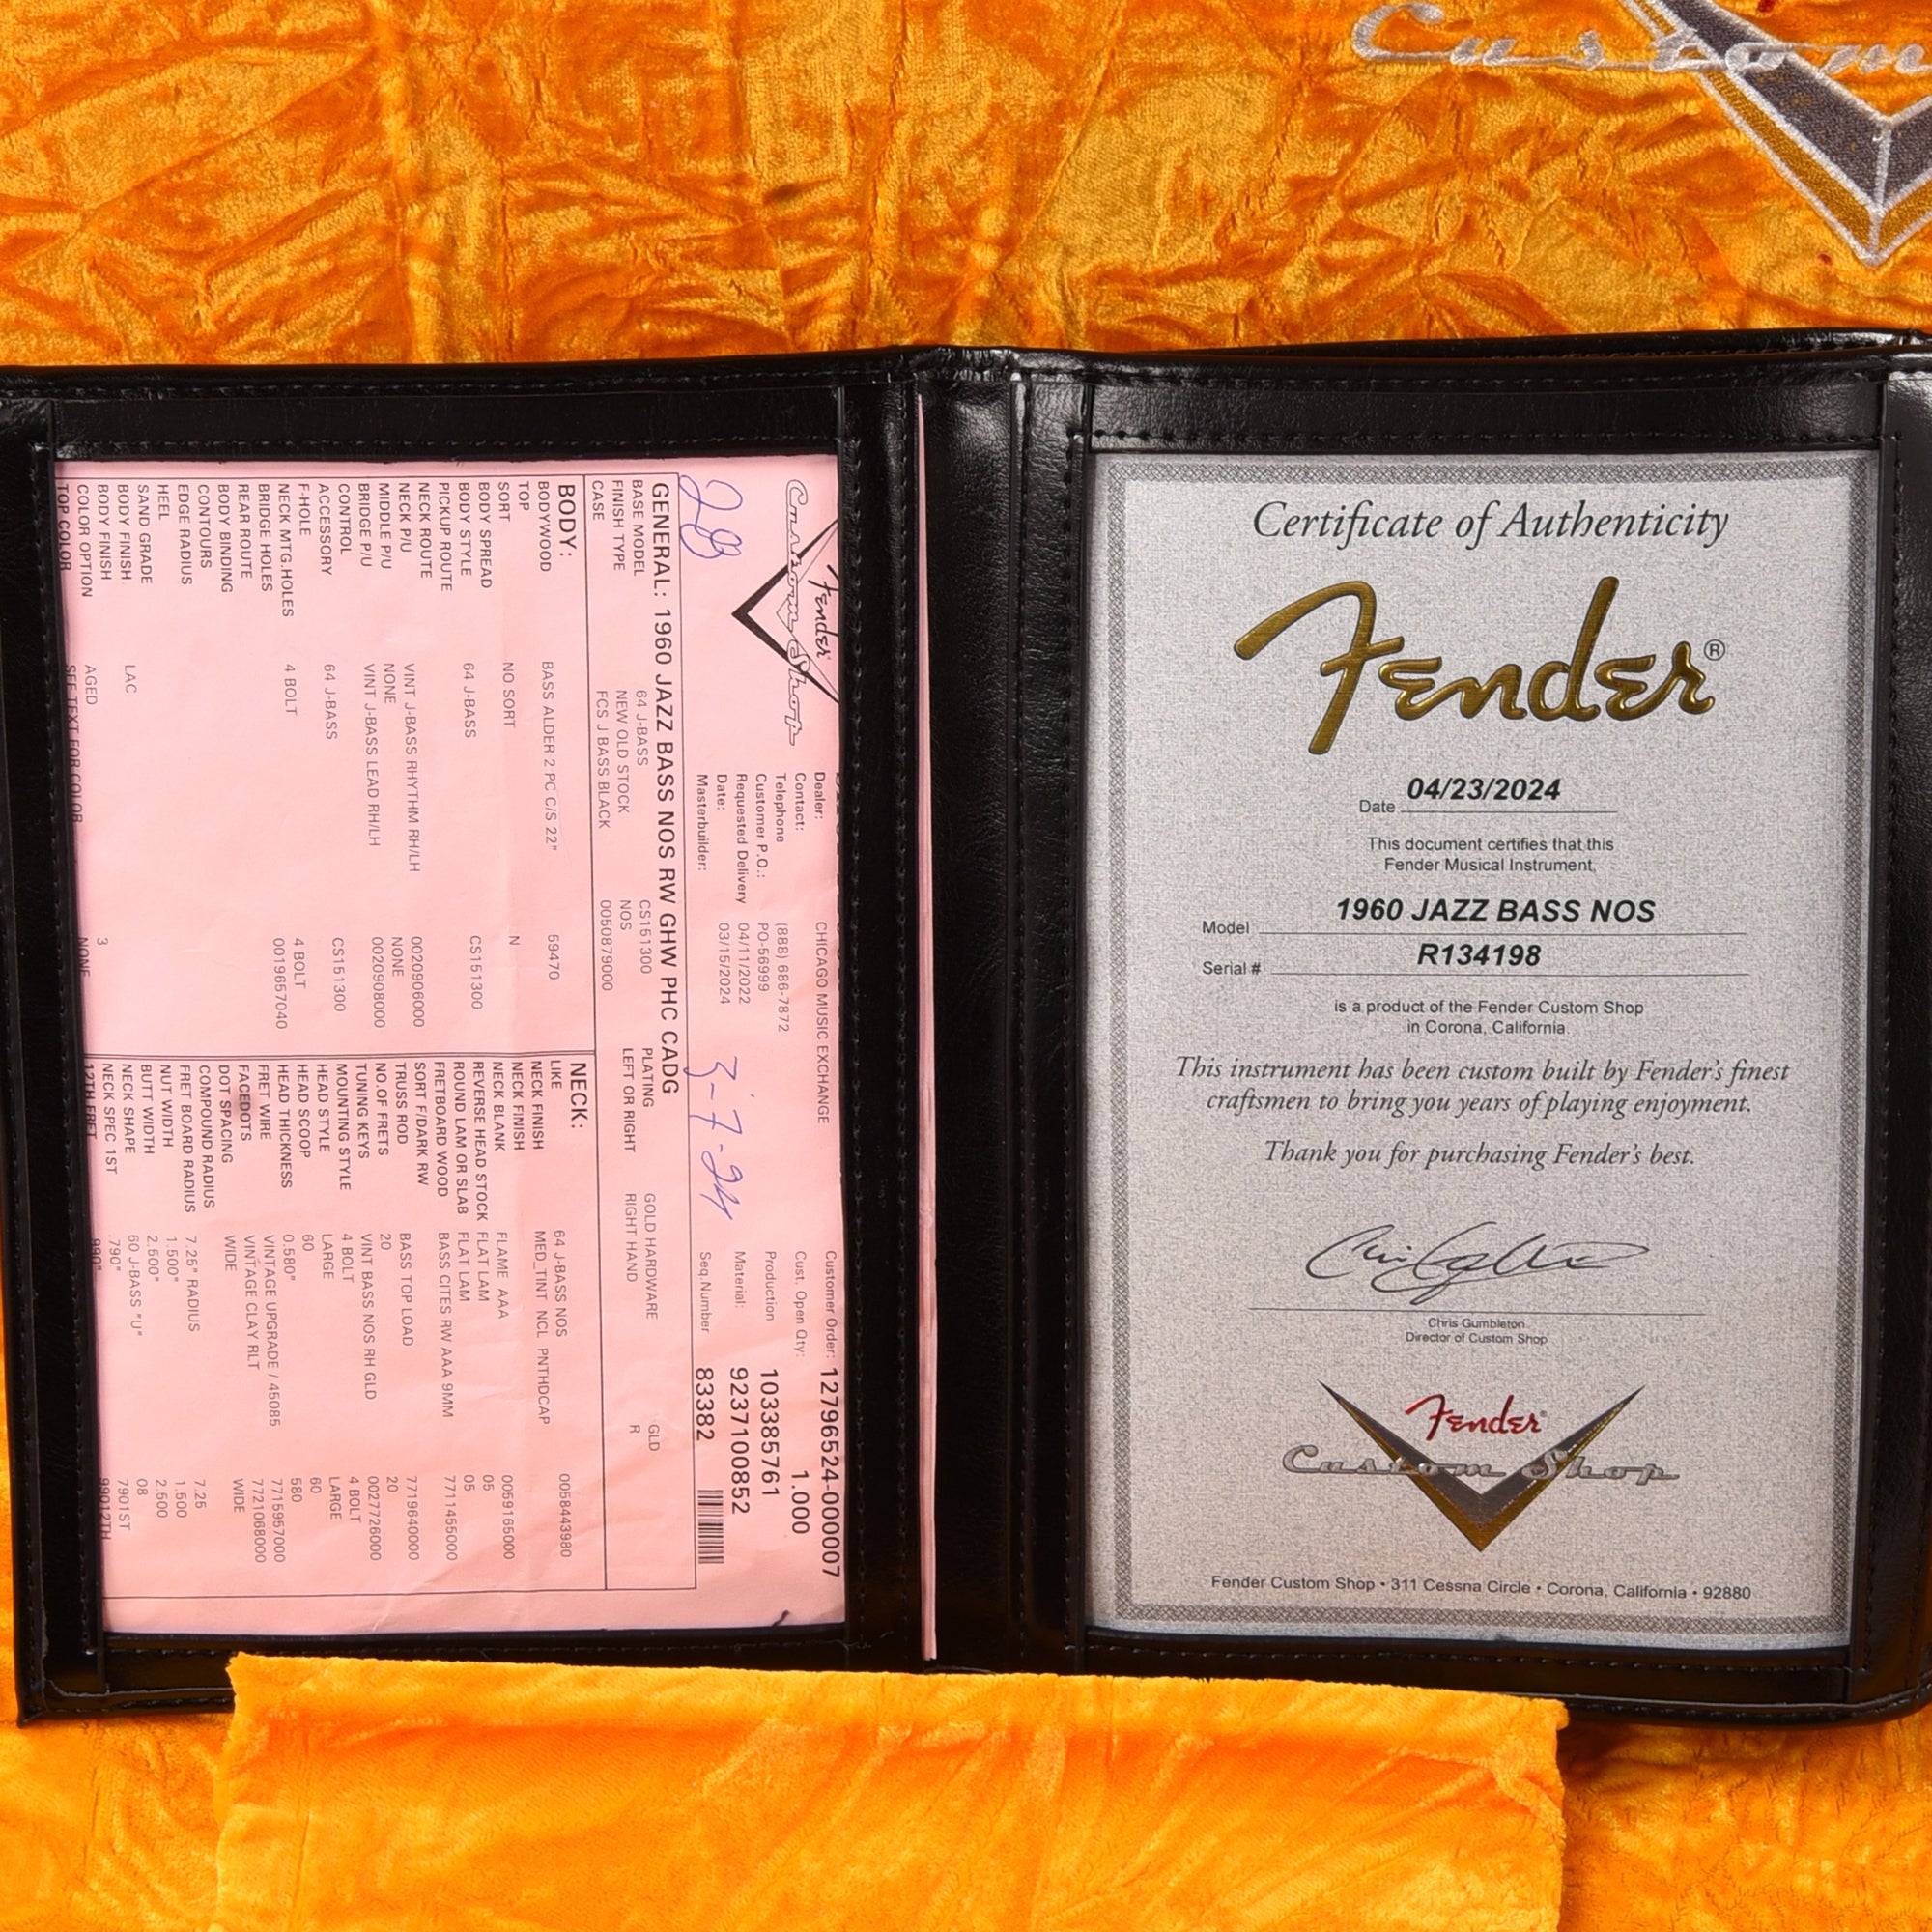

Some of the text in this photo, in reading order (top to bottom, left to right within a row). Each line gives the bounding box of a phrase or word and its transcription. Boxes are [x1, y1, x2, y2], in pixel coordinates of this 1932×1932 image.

[157, 484, 170, 520] HEEL
[198, 484, 212, 568] CONTOURS
[319, 483, 332, 575] ACCESSORY
[338, 483, 352, 554] CONTROL
[538, 481, 552, 572] BODYWOOD
[558, 484, 577, 556] BODY:
[1253, 499, 1729, 551] Certificate of Authenticity
[77, 484, 93, 597] COLOR OPTION
[439, 482, 452, 591] PICKUP ROUTE
[784, 479, 810, 746] Custom Shop
[85, 665, 98, 705] AGED
[125, 665, 137, 693] LAC
[652, 483, 679, 1094] GENERAL: 1960 JAZZ BASS NOS RW GHW PHC CADG
[717, 774, 728, 810] Date:
[755, 773, 769, 840] Customer
[774, 773, 787, 842] Telephone
[795, 772, 807, 830] Contact:
[814, 772, 826, 821] Dealer:
[1359, 799, 1396, 813] Date
[1407, 777, 1561, 801] 04/23/2024
[697, 774, 709, 870] Masterbuilder:
[734, 774, 749, 904] Requested Delivery
[1367, 834, 1614, 851] This document certifies that this
[1384, 857, 1440, 871] Fender
[1444, 857, 1504, 871] Musical
[1202, 921, 1250, 936] Model
[1337, 897, 1656, 923] 1960 JAZZ BASS NOS
[273, 938, 287, 1029] 0019657040
[411, 936, 425, 1027] 0020906000
[548, 934, 560, 980] 59470
[719, 923, 730, 1004] 03/15/2024
[738, 923, 751, 1004] 04/11/2022
[757, 923, 769, 991] PO-56999
[776, 923, 790, 1032] (888) 686-7872
[1202, 960, 1247, 976] Serial
[1417, 943, 1542, 967] R134198
[816, 922, 829, 1122] CHICAGO MUSIC EXCHANGE
[1334, 999, 1644, 1017] is a product of the Fender Custom Shop
[1407, 1019, 1420, 1034] in
[1425, 1019, 1487, 1036] Corona,
[551, 1060, 562, 1089] LIKE
[570, 1063, 588, 1128] NECK:
[642, 1048, 654, 1107] PLATING
[1177, 1055, 1222, 1078] This
[1230, 1058, 1352, 1079] instrument
[1357, 1057, 1394, 1079] has
[1401, 1057, 1450, 1080] been
[1458, 1065, 1534, 1081] custom
[1542, 1058, 1597, 1081] built
[1603, 1059, 1629, 1089] by
[1724, 1058, 1790, 1089] finest
[1207, 1087, 1750, 1121] craftsmen to bring you years of playing enjoyment.
[199, 1065, 215, 1208] COMPOUND RADIUS
[434, 1062, 448, 1197] FRETBOARD WOOD
[493, 1062, 505, 1151] NECK BLANK
[1265, 1139, 1337, 1162] Thank
[1340, 1149, 1381, 1169] you
[1383, 1140, 1421, 1170] for
[1424, 1141, 1548, 1172] purchasing
[1649, 1142, 1694, 1165] best.
[644, 1193, 658, 1318] GOLD HARDWARE
[735, 1252, 746, 1309] Material:
[765, 1251, 777, 1321] Production
[244, 1236, 260, 1369] VINTAGE CLAY RLT
[794, 1291, 807, 1323] Open
[826, 1251, 838, 1359] Customer Order:
[1428, 1318, 1525, 1329] Chris Gumbleton
[794, 1329, 807, 1357] Qty:
[1406, 1331, 1549, 1346] Director of Custom Shop
[695, 1367, 715, 1441] 83382
[760, 1369, 780, 1495] 103385761
[1405, 1394, 1547, 1441] Fender
[648, 1424, 660, 1451] GLD
[729, 1367, 751, 1514] 9237100852
[1283, 1445, 1681, 1486] Custom Shop
[233, 1479, 245, 1512] WIDE
[791, 1470, 810, 1534] 1.000
[820, 1368, 839, 1577] 12796524-000007
[272, 1480, 285, 1562] 7715957000
[559, 1473, 571, 1557] 0058443980
[1211, 1575, 1751, 1600] Fender Custom Shop 311 Cessna Circle Corona, California 92880
